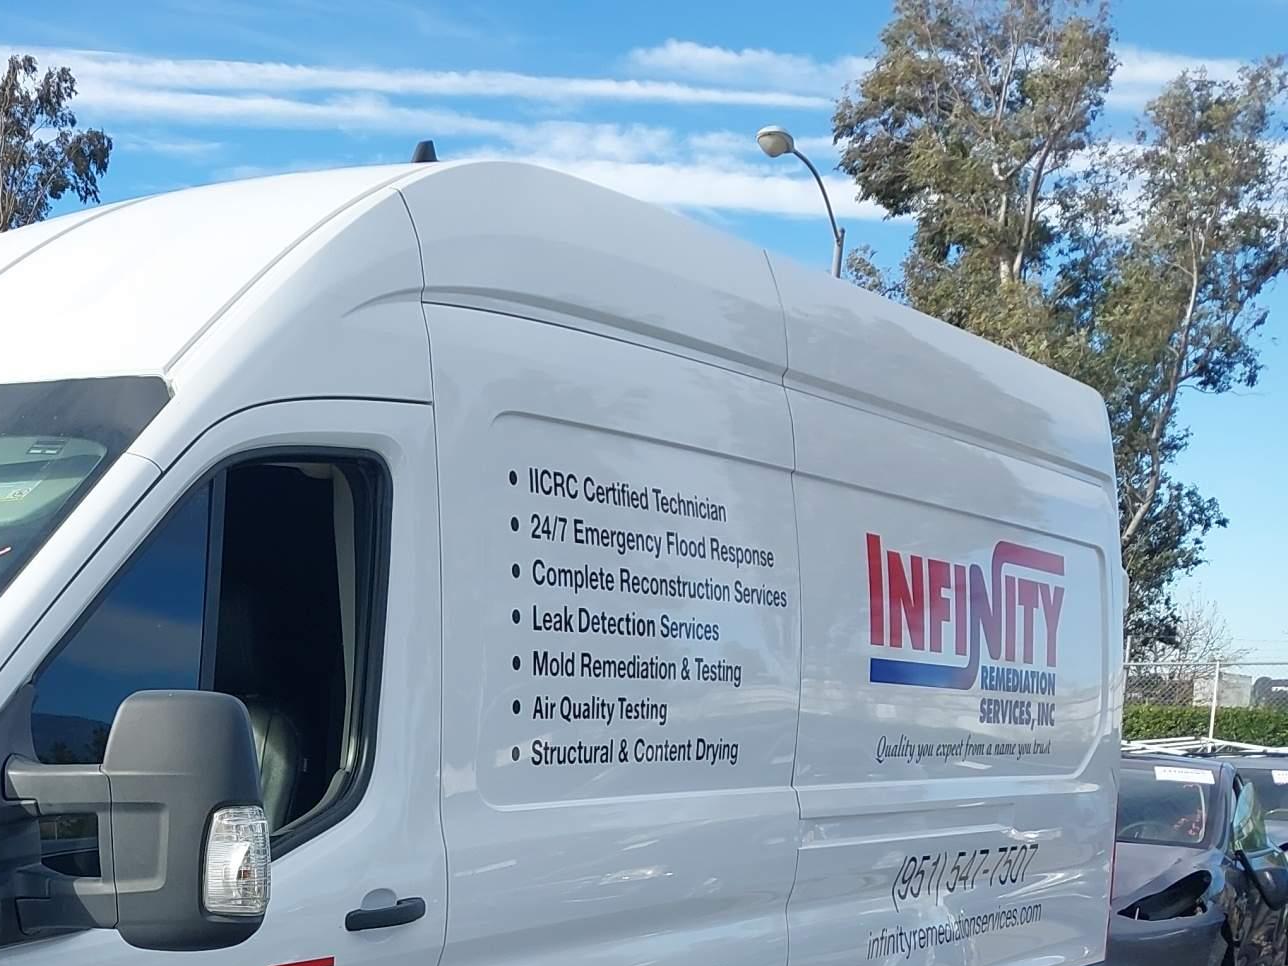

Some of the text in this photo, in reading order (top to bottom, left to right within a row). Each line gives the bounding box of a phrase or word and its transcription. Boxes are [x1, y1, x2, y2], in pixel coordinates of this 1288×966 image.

[529, 467, 727, 522] IICRC Certified Technician
[530, 514, 774, 568] 24/7 Emergency Flood Response
[532, 559, 787, 608] Complete Reconstruction Services
[533, 605, 719, 641] Leak Detection Services
[866, 532, 1065, 690] INFINITY
[533, 651, 741, 687] Mold Remediation & Testing
[980, 665, 1056, 696] REMEDIATION
[533, 695, 667, 725] Air Quality Testing
[979, 698, 1055, 730] SERVICES, INC
[531, 738, 738, 766] Structural & Content Drying
[876, 735, 1051, 763] Quality you expect from a name you trust
[892, 844, 1039, 912] (951) 547-7507
[866, 903, 1042, 960] infinityremediationservices.com
